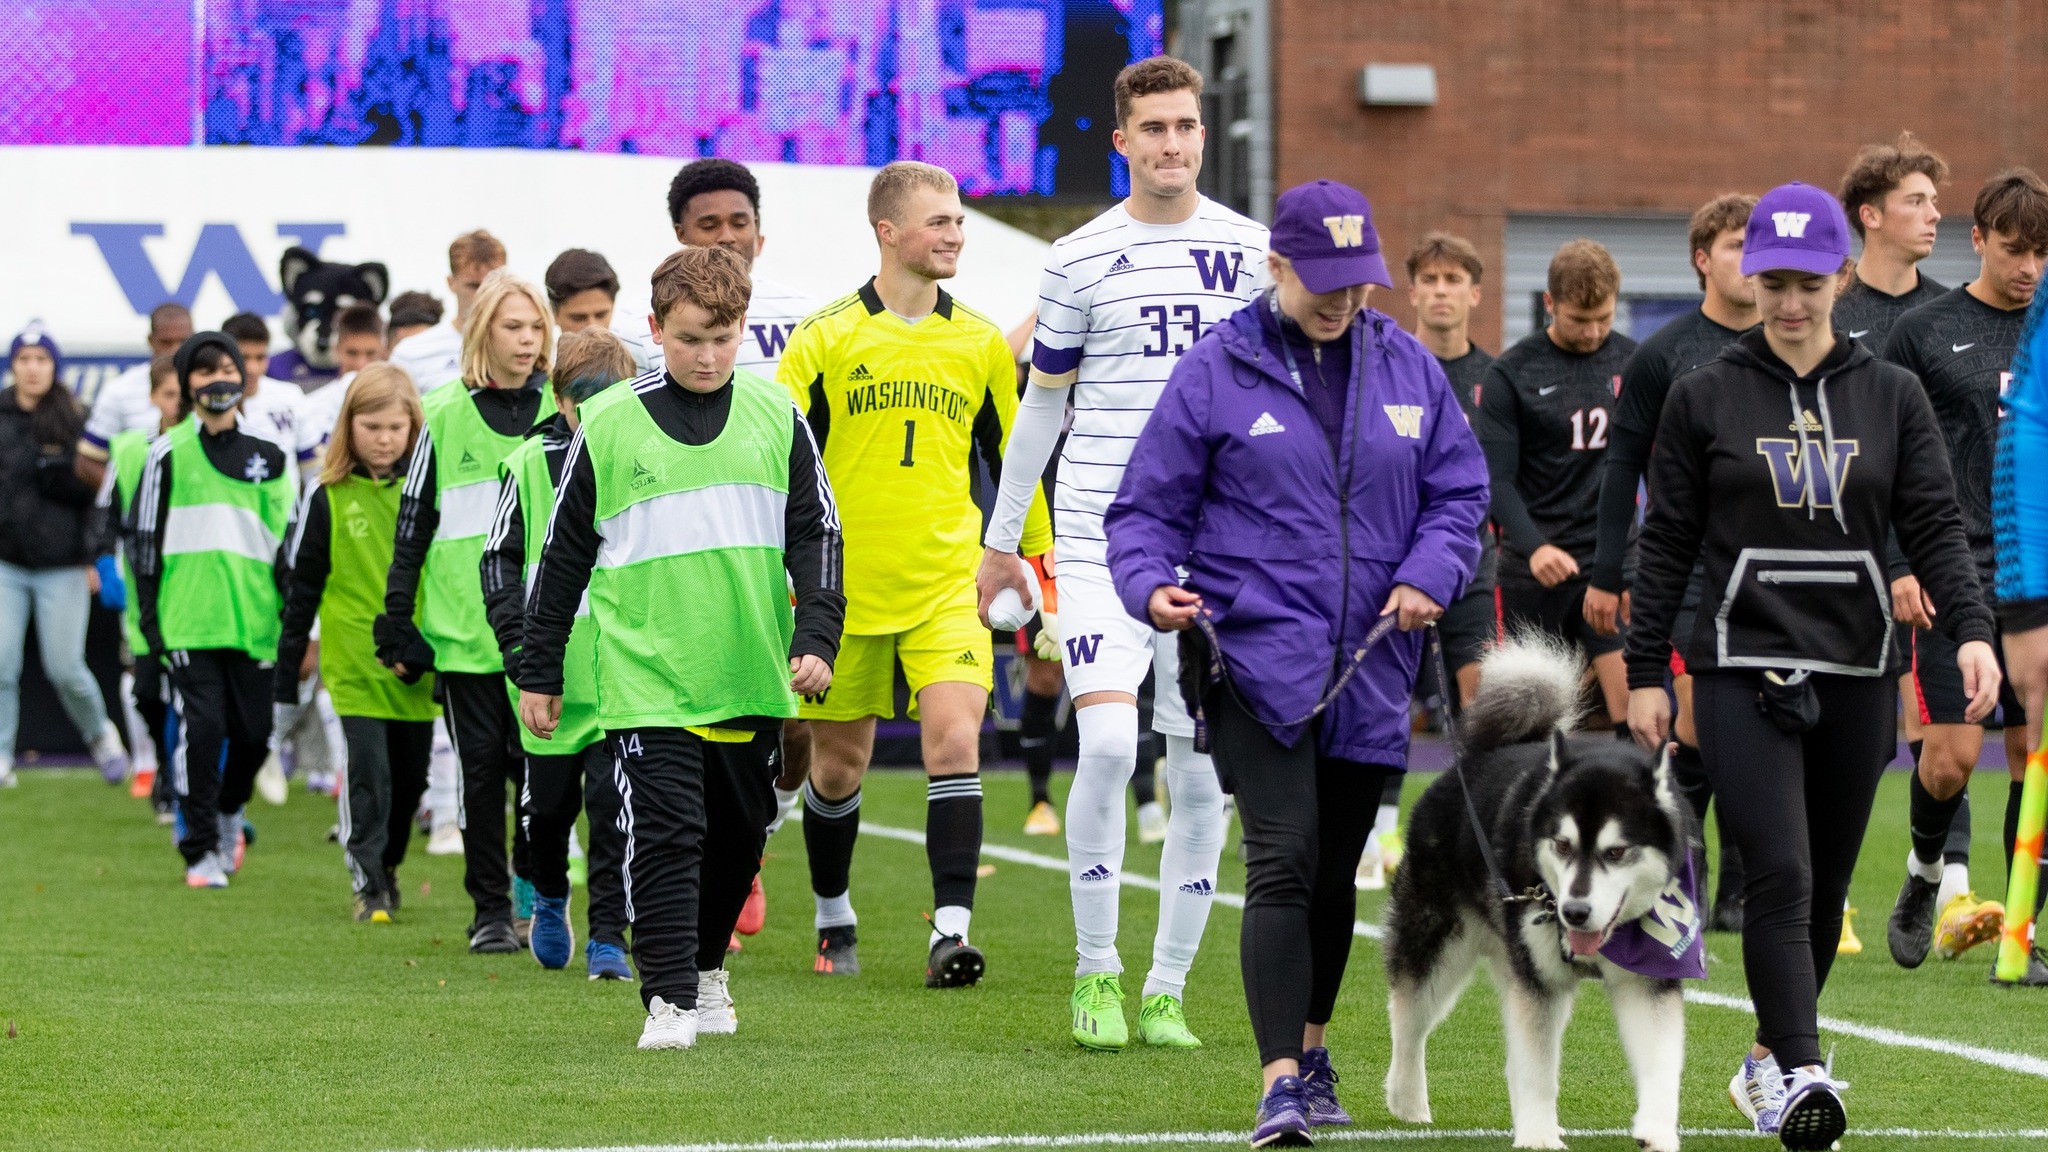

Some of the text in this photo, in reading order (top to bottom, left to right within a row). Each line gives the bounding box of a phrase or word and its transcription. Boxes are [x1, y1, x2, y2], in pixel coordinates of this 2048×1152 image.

[1323, 215, 1364, 248] W
[1771, 212, 1812, 239] W
[69, 223, 346, 316] W
[1109, 262, 1134, 273] adidas
[1189, 249, 1243, 292] W
[749, 324, 796, 358] W
[1140, 305, 1201, 357] 33
[847, 373, 874, 381] adidas
[847, 381, 968, 427] WASHINGTON
[1249, 424, 1285, 437] adidas
[1383, 404, 1424, 439] W
[1570, 407, 1609, 450] 12
[1788, 423, 1823, 432] adas
[900, 420, 916, 467] 1
[1756, 438, 1859, 508] W
[1066, 634, 1103, 667] W
[619, 733, 644, 759] 14
[1080, 872, 1114, 881] adidas
[1179, 886, 1213, 896] adidas
